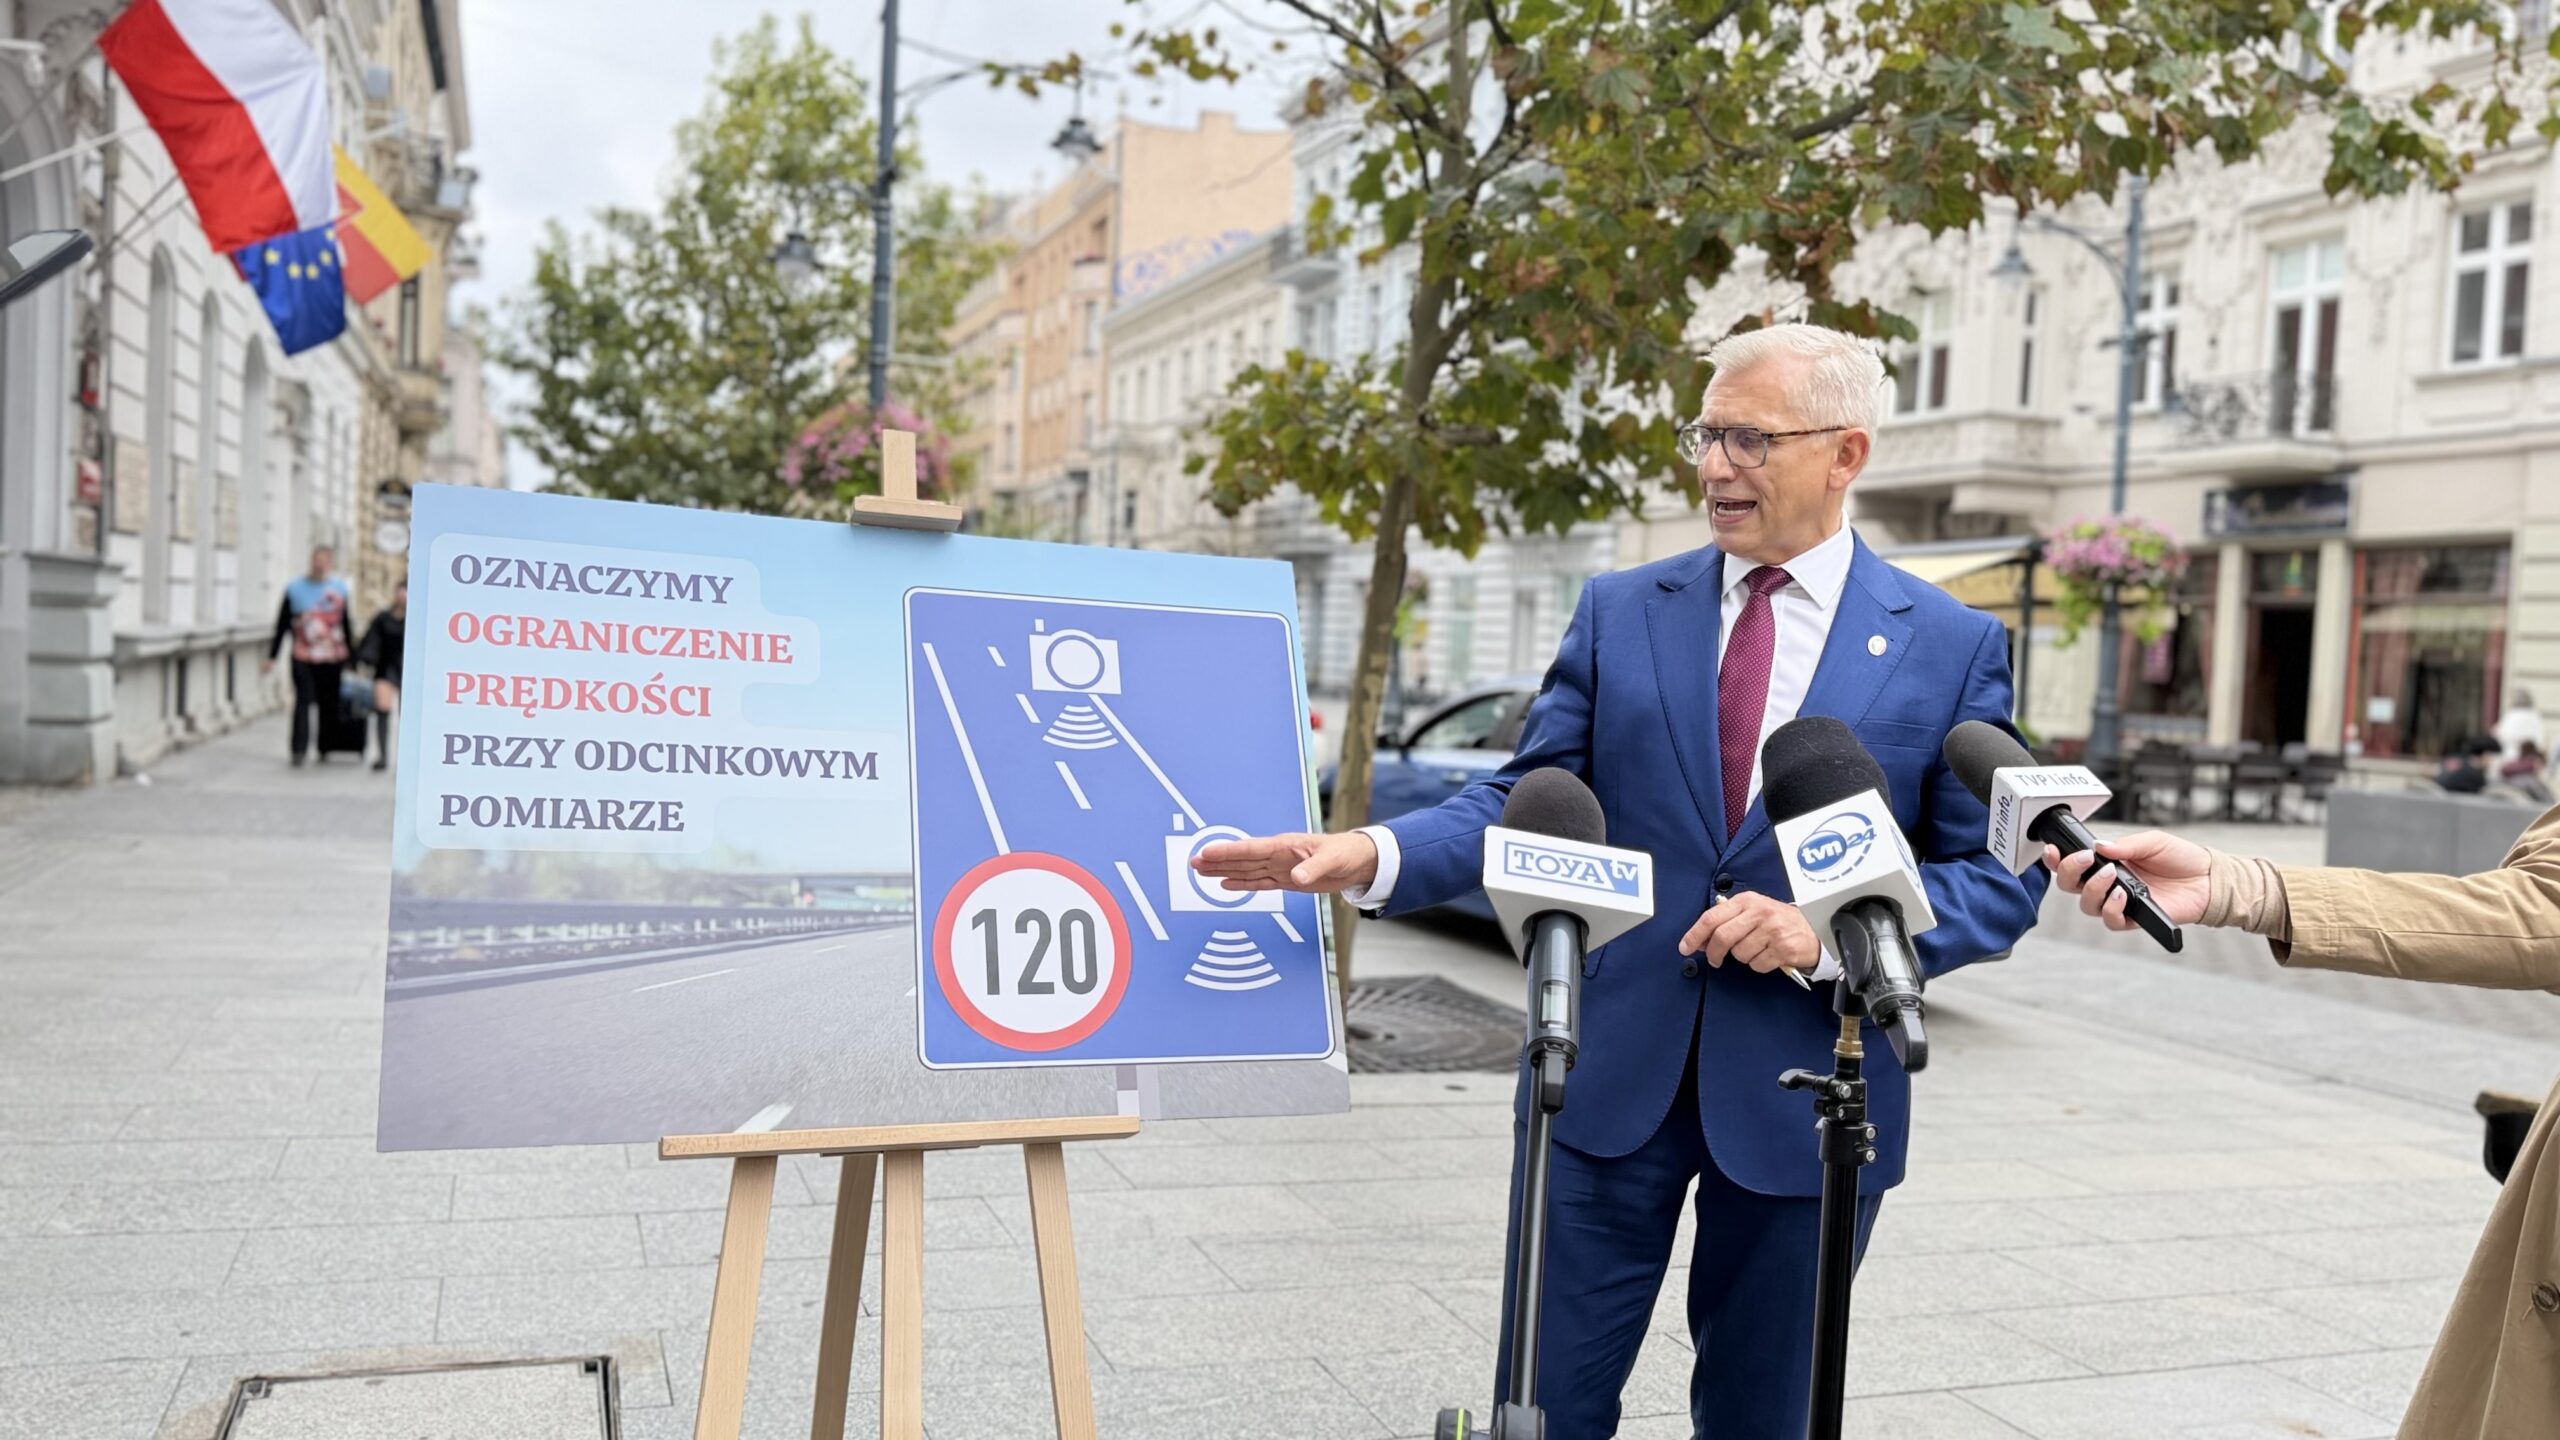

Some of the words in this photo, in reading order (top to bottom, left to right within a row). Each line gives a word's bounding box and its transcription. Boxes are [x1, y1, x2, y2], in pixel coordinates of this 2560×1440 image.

[450, 553, 734, 604] OZNACZYMY
[447, 611, 794, 665] OGRANICZENIE
[445, 672, 712, 719] PRĘDKOŚCI
[442, 733, 565, 770] PRZY
[574, 740, 880, 781] ODCINKOWYM
[439, 794, 685, 832] POMIARZE
[1514, 849, 1605, 885] TOYA
[971, 908, 1098, 995] 120
